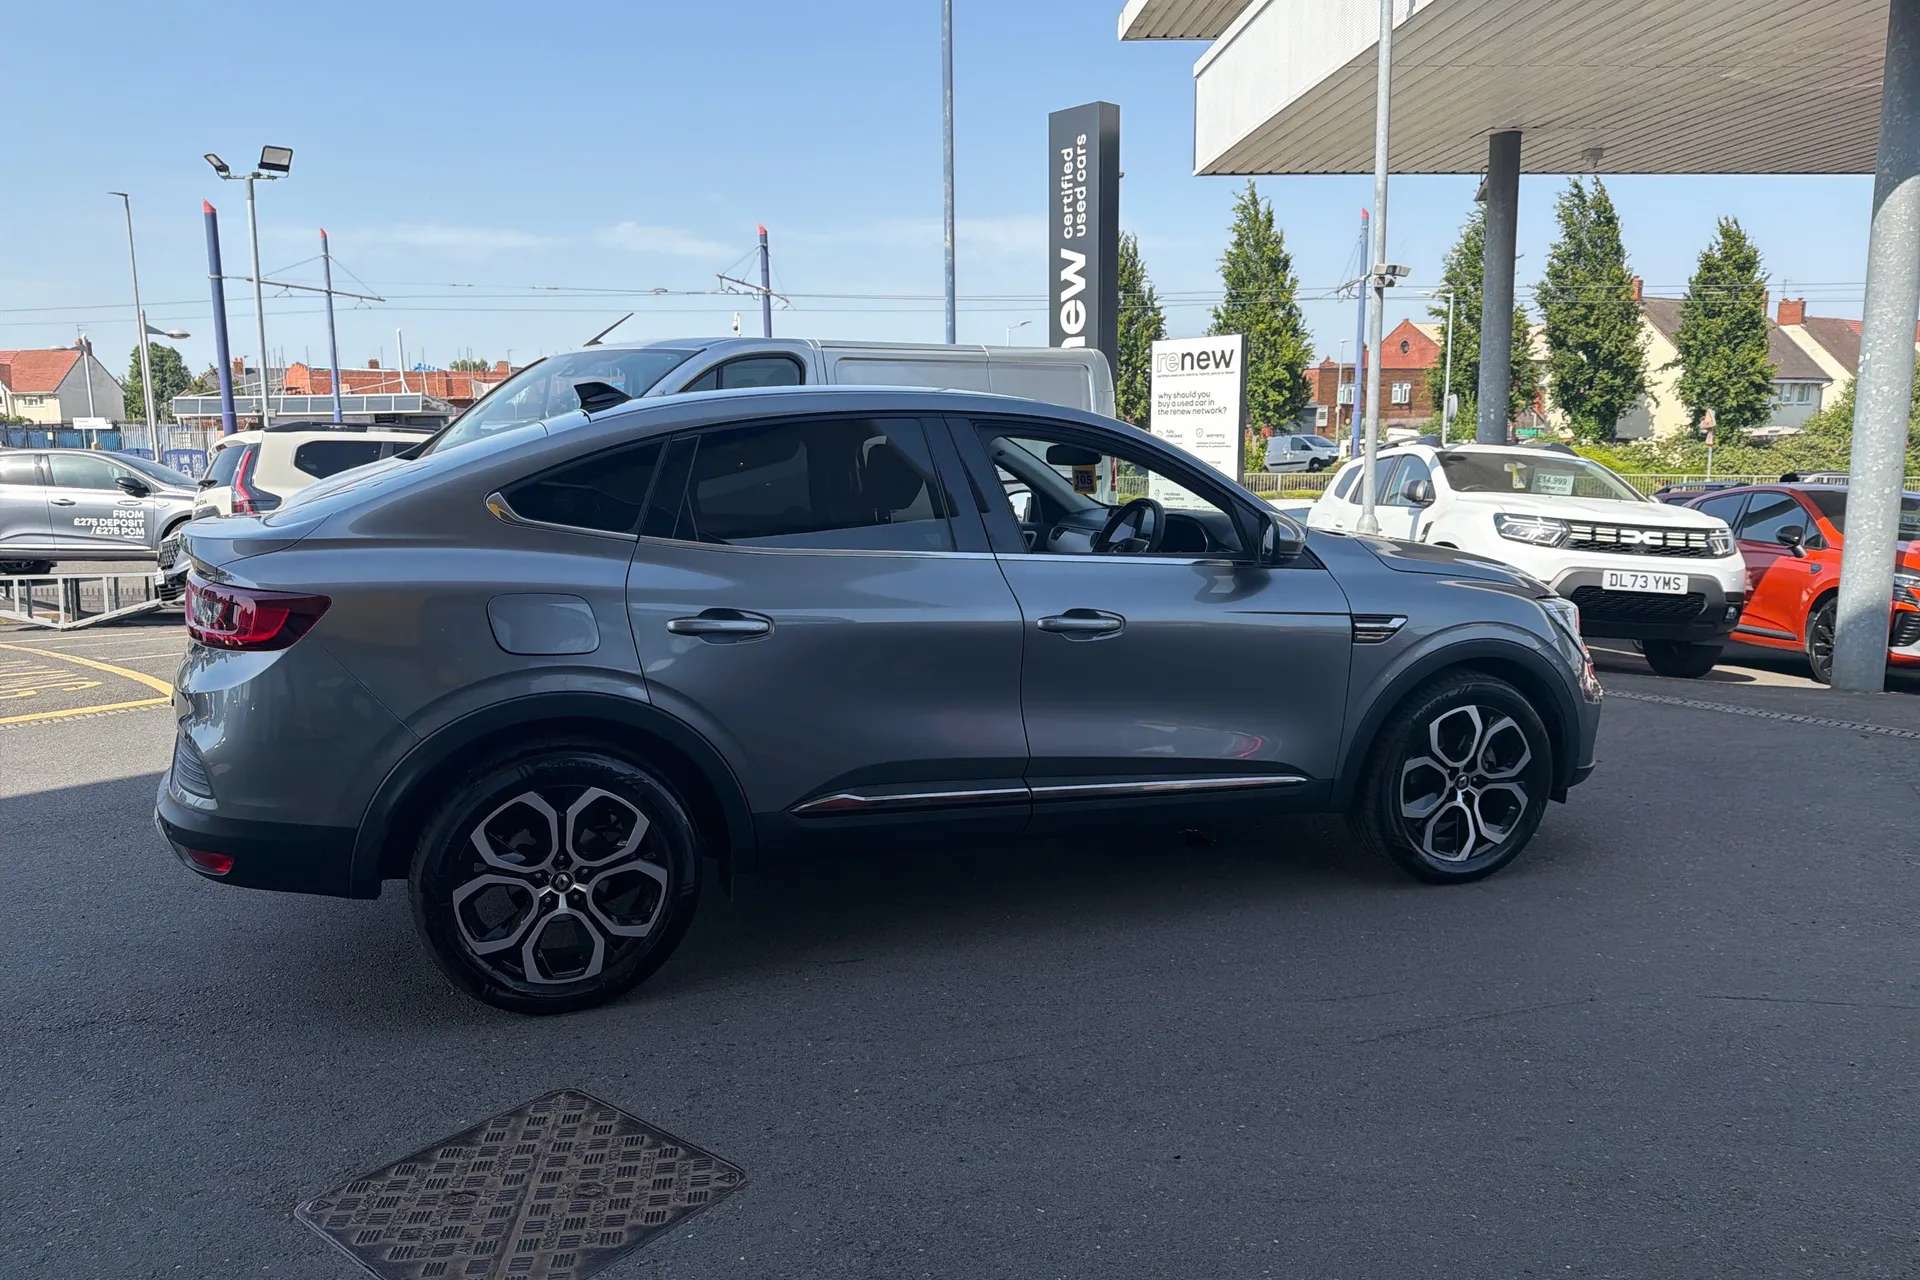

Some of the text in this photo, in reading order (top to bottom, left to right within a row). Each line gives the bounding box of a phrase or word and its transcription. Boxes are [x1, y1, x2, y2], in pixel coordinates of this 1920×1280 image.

[1074, 133, 1087, 237] used cars
[1061, 147, 1073, 239] certified
[1156, 349, 1235, 373] renew
[1158, 390, 1211, 400] why should you
[1157, 400, 1171, 408] buy
[1177, 399, 1194, 407] used
[1192, 406, 1227, 415] network?
[113, 510, 144, 518] FROM
[74, 518, 144, 526] £275 DEPOSIT
[121, 527, 144, 535] PCM
[1609, 573, 1681, 591] DL73 YMS
